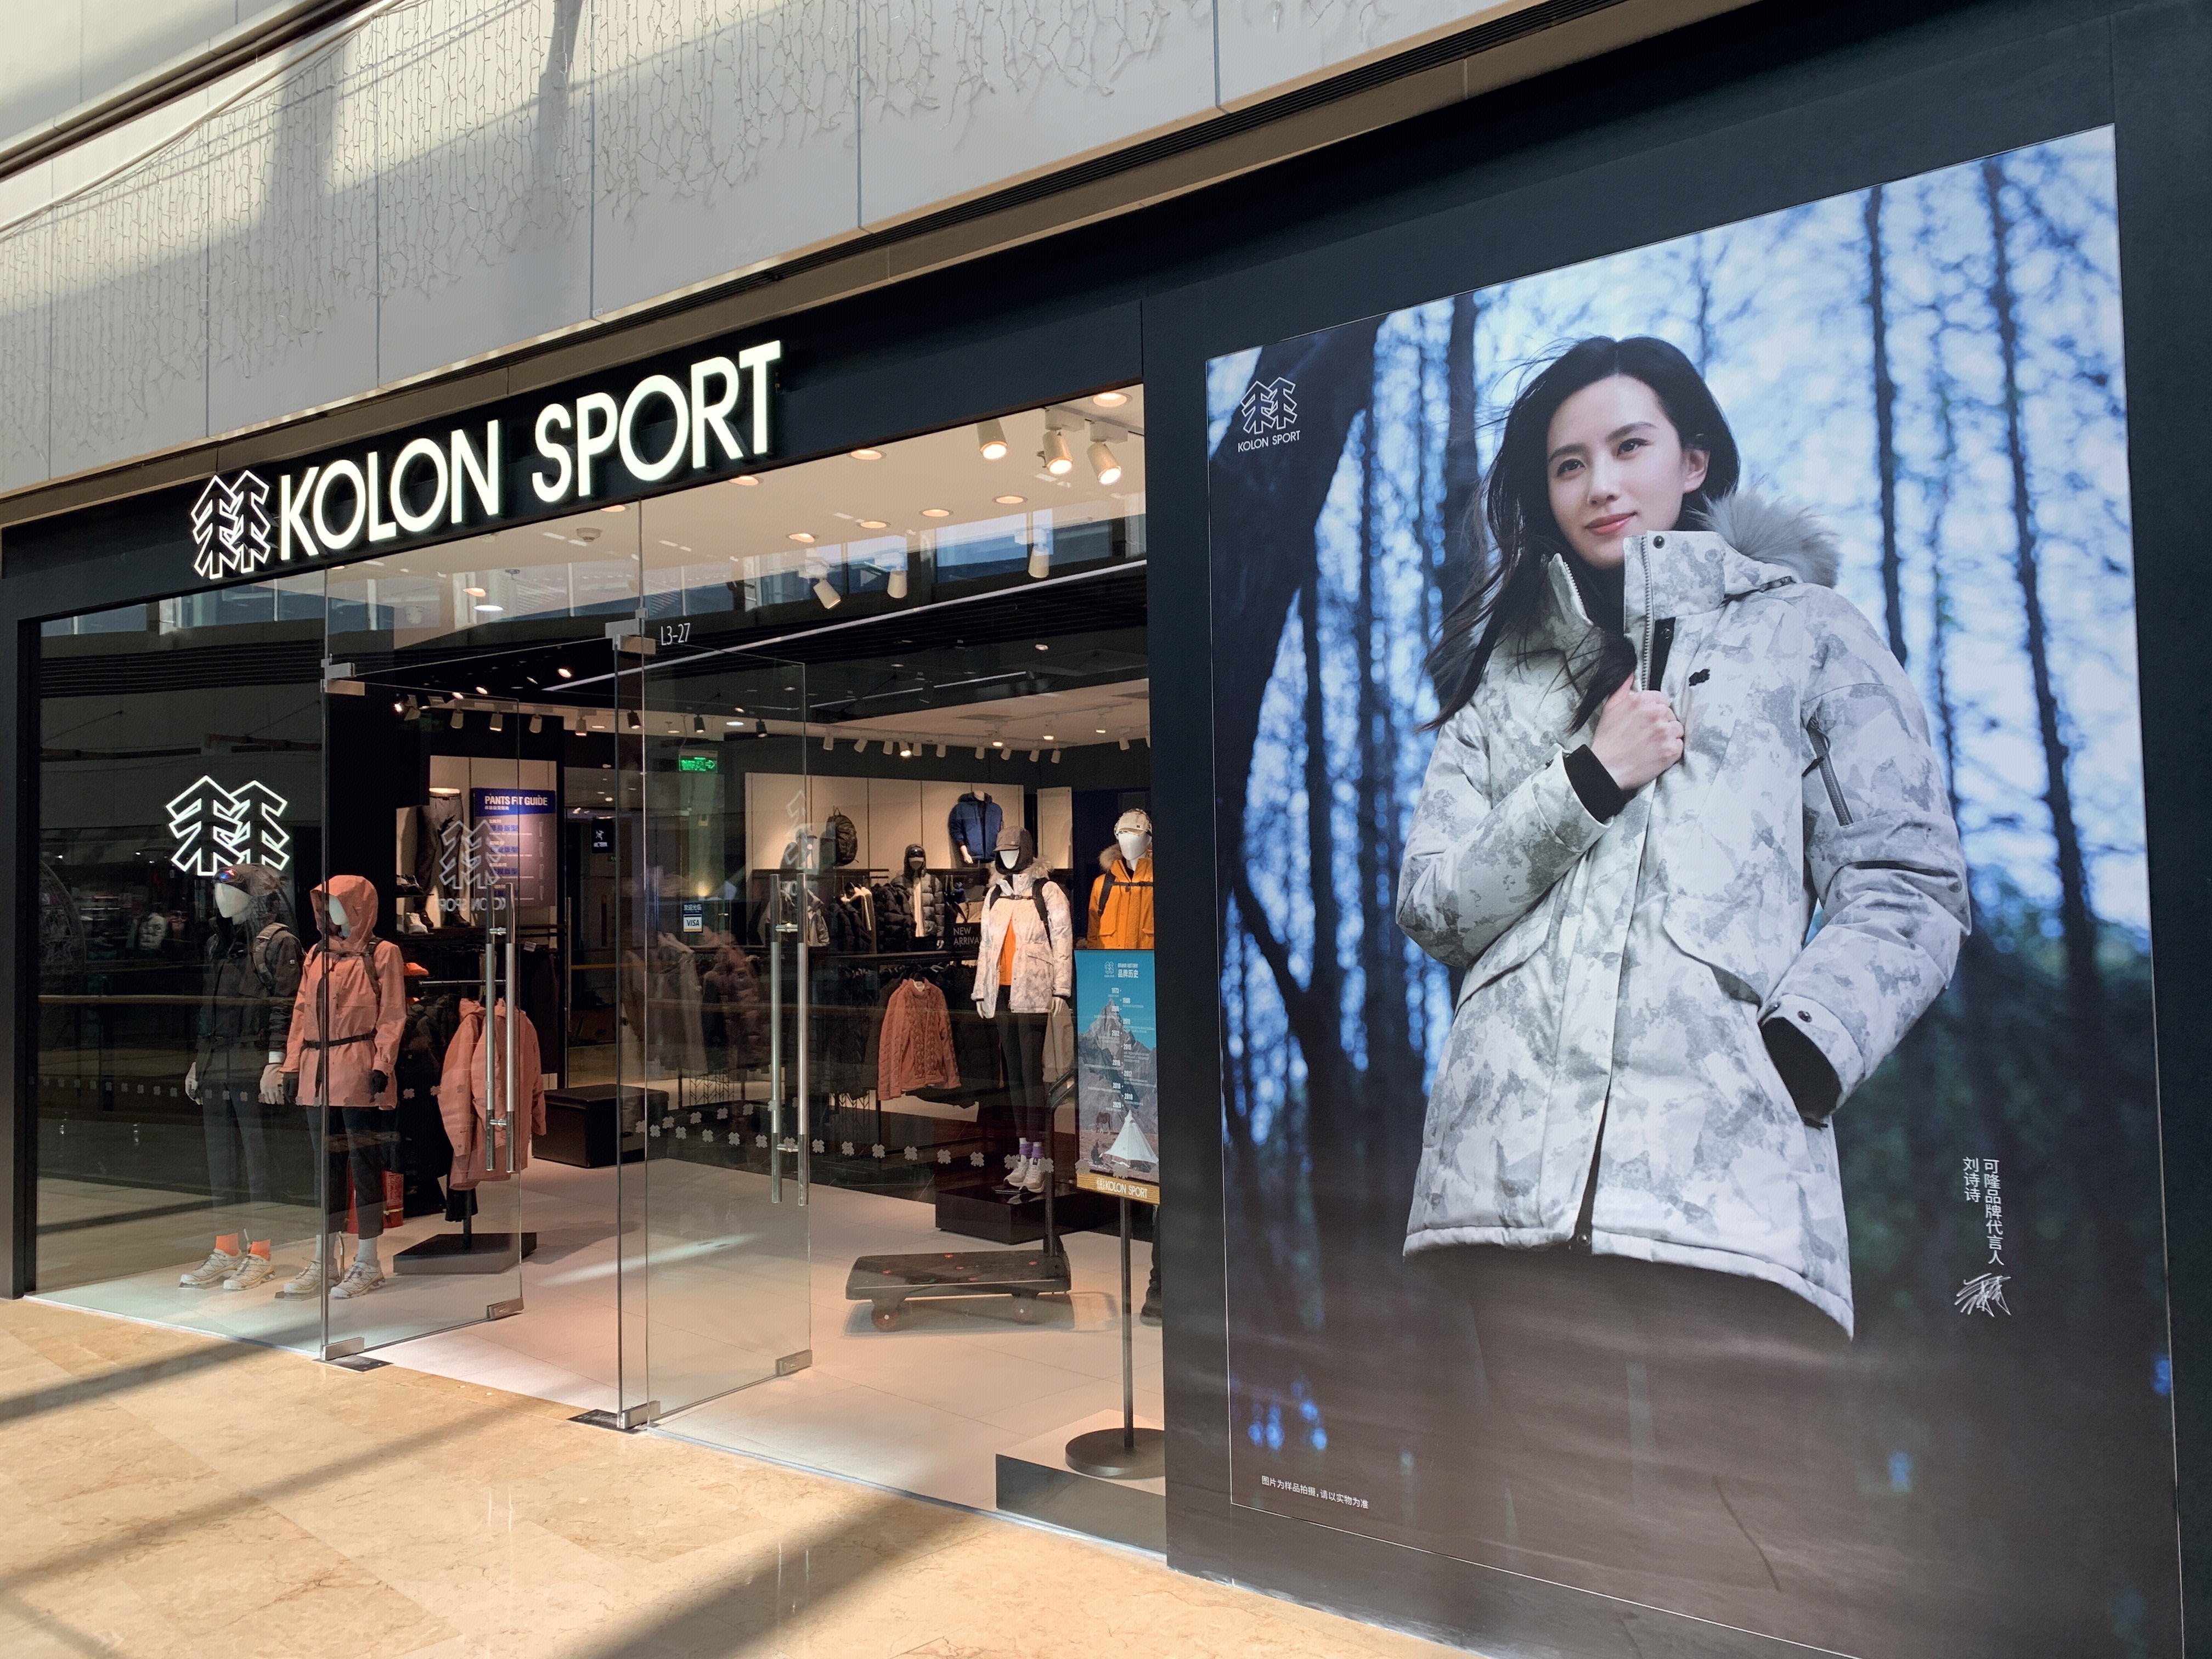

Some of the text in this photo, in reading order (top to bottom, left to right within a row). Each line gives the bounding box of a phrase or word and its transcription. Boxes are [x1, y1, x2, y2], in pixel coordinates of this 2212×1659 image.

[280, 340, 781, 561] KOLON SPORT
[1238, 430, 1301, 453] KOLON SPORT
[661, 622, 691, 646] L3-27
[484, 795, 548, 806] PANTS FIT GUIDE
[953, 927, 972, 935] NEW
[1118, 969, 1139, 978] 品牌历史
[1105, 1180, 1148, 1199] KOLON SPORT
[1963, 1156, 1981, 1203] 刘诗诗
[1983, 1158, 2004, 1266] 可隆品牌代言人
